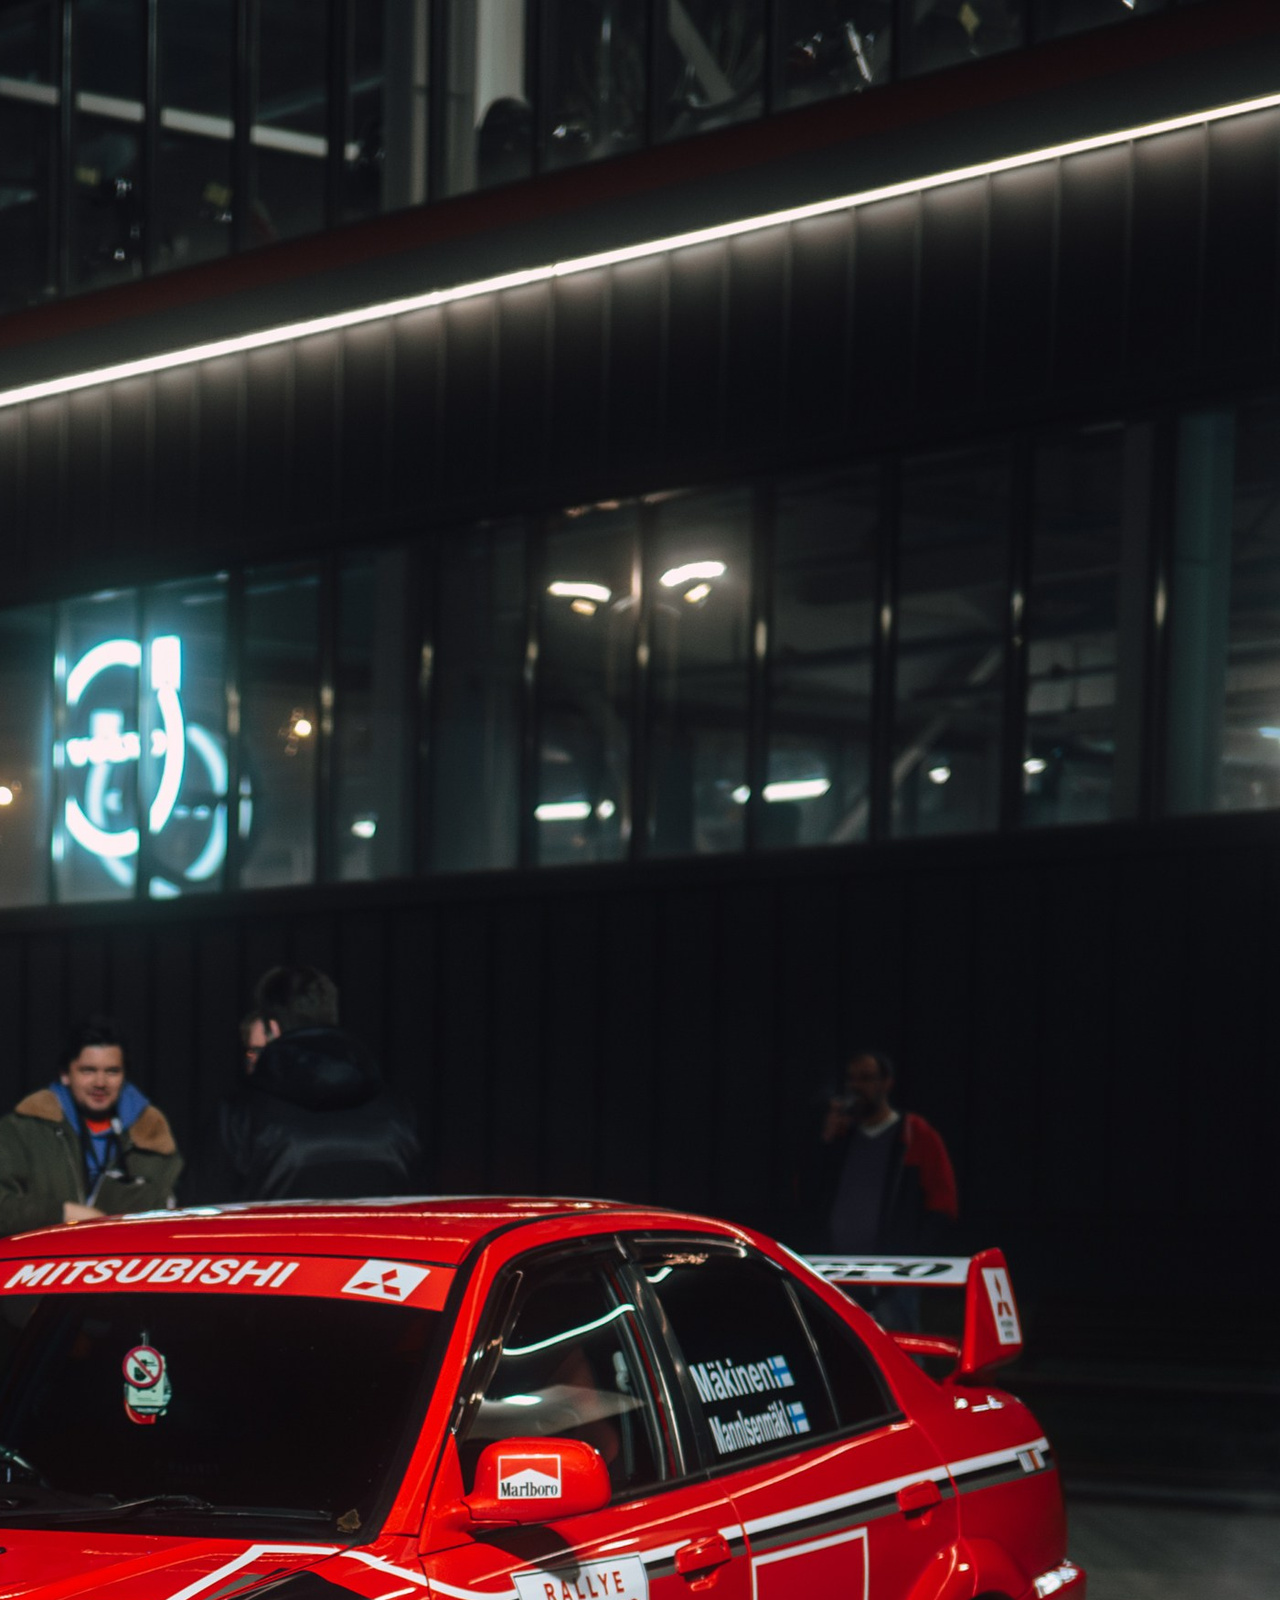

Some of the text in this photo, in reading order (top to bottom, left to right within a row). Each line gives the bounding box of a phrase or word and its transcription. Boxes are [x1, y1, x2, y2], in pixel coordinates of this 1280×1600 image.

[5, 1257, 300, 1289] MITSUBISHI
[689, 1358, 776, 1403] Mäkinen
[501, 1482, 558, 1497] Marlboro
